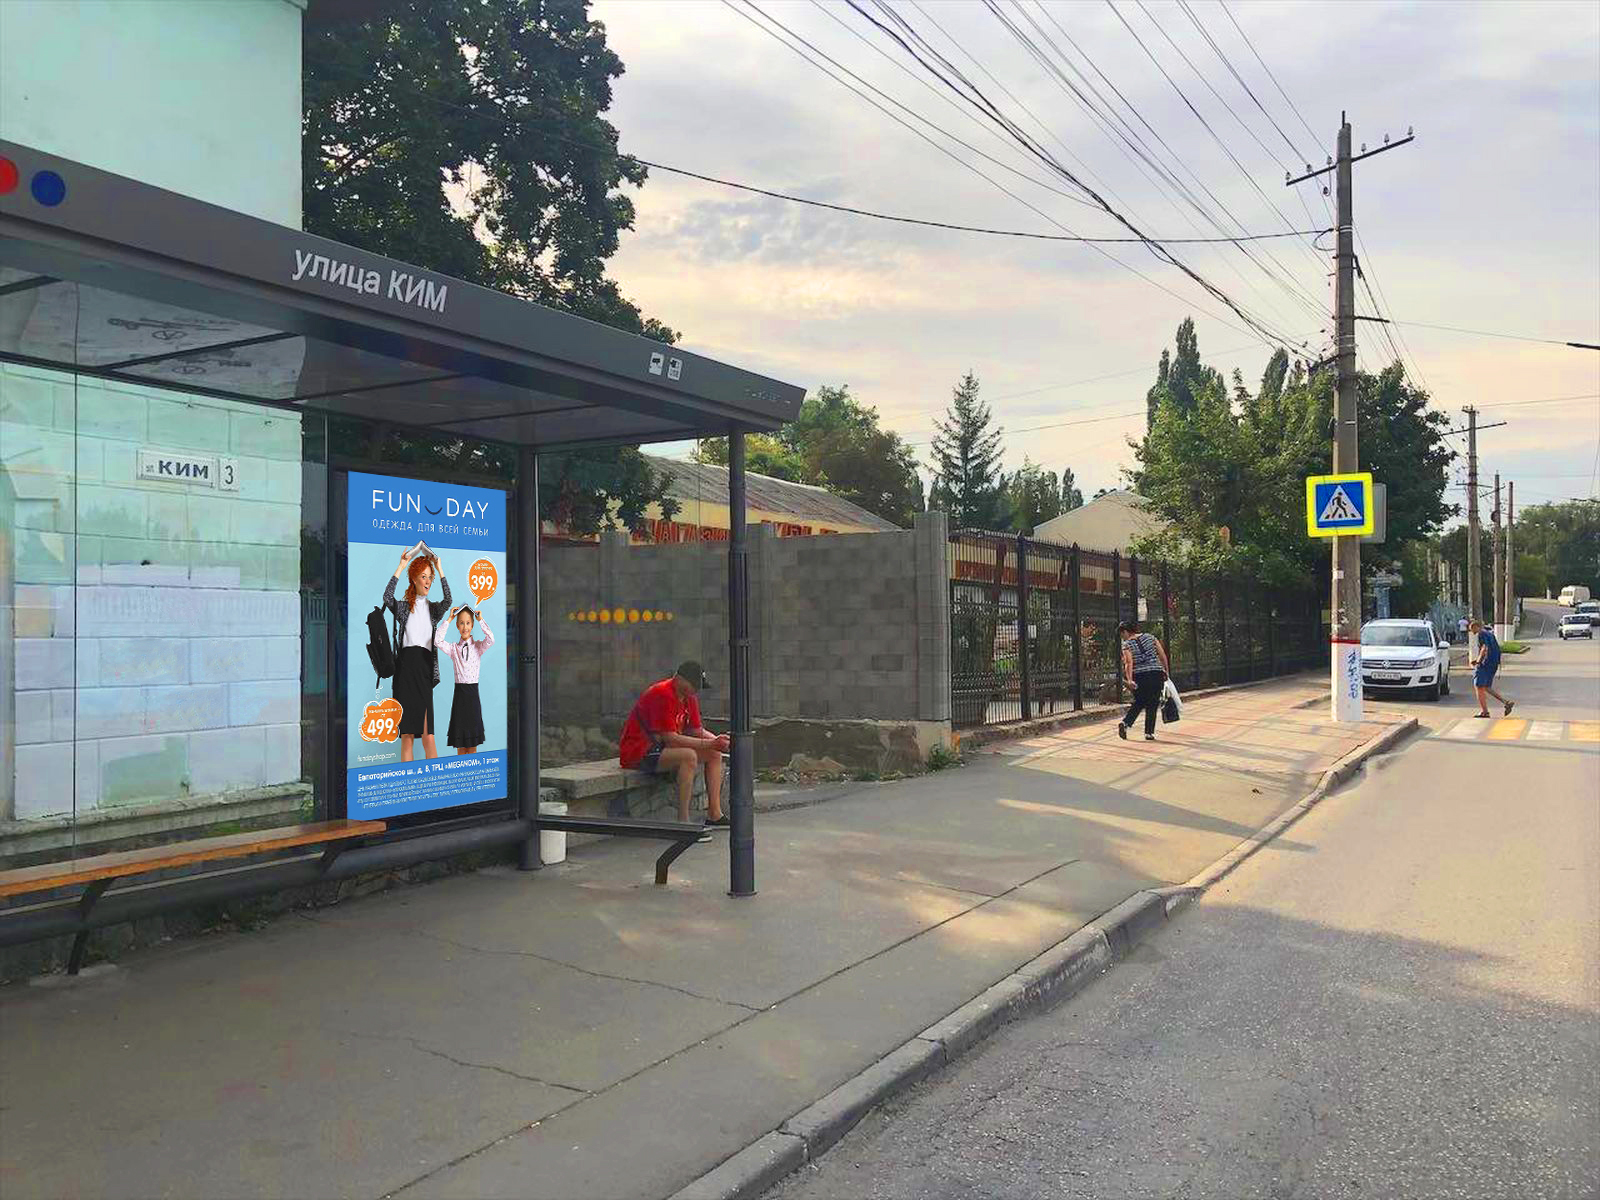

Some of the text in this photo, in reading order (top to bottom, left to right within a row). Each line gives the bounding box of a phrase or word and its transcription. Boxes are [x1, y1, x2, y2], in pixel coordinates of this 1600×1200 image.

[292, 250, 448, 313] улица КИМ
[158, 460, 208, 479] КИМ
[224, 465, 233, 484] 3
[372, 489, 489, 519] FUN DAY
[372, 518, 489, 537] ОДЕЖДА ДЛЯ ВСЕЙ СЕМЬИ
